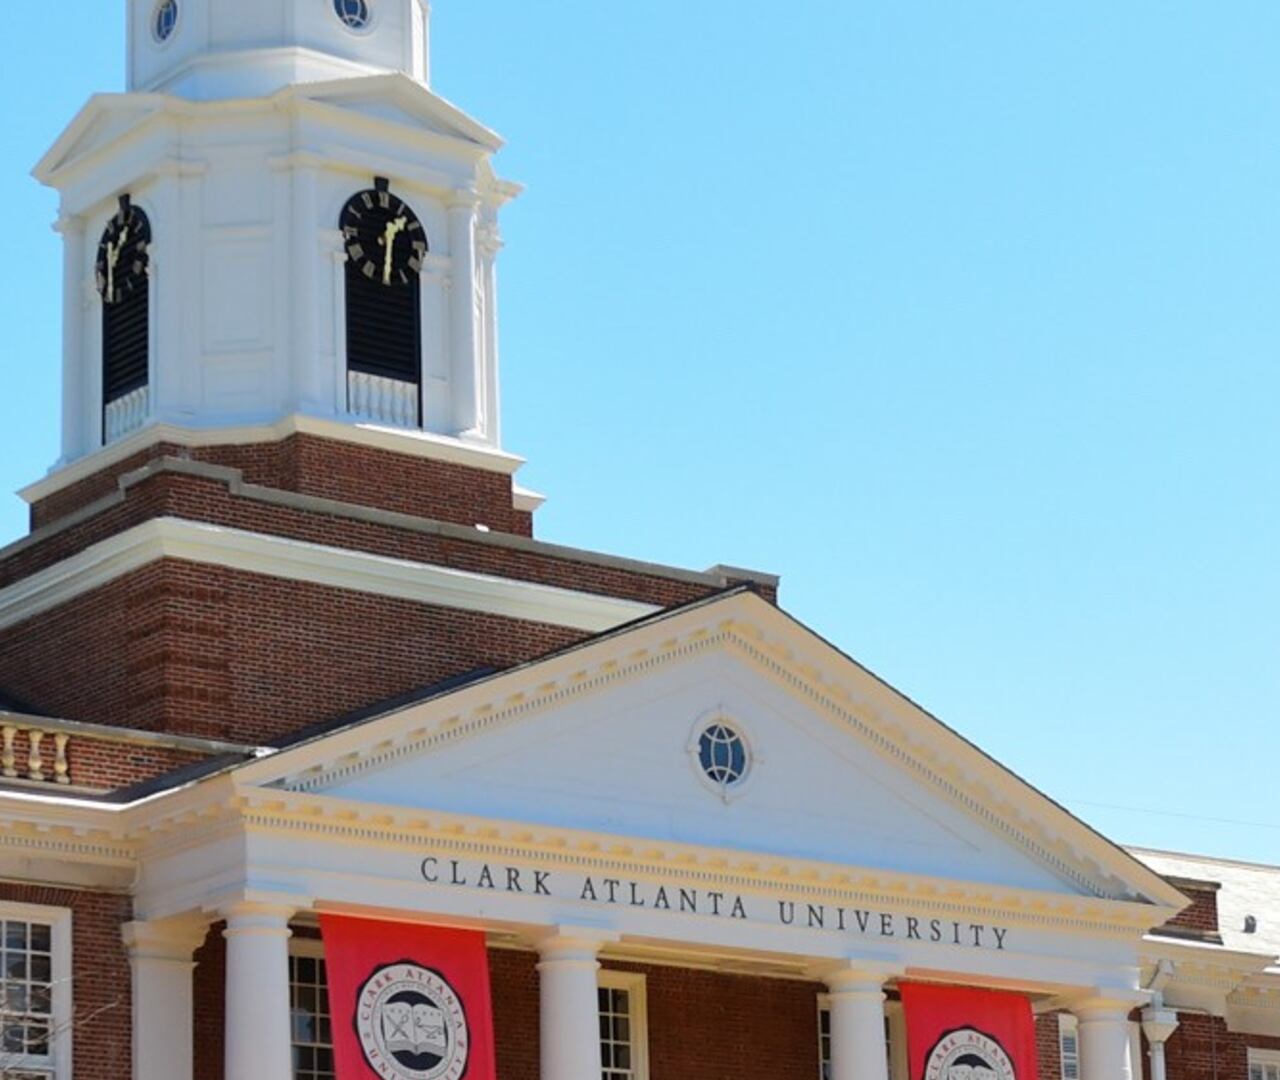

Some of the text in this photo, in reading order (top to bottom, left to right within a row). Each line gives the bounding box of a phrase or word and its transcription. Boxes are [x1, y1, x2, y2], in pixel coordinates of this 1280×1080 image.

[420, 857, 1008, 949] CLARK ATLANTA UNIVERSITY
[361, 968, 393, 1021] CLARK
